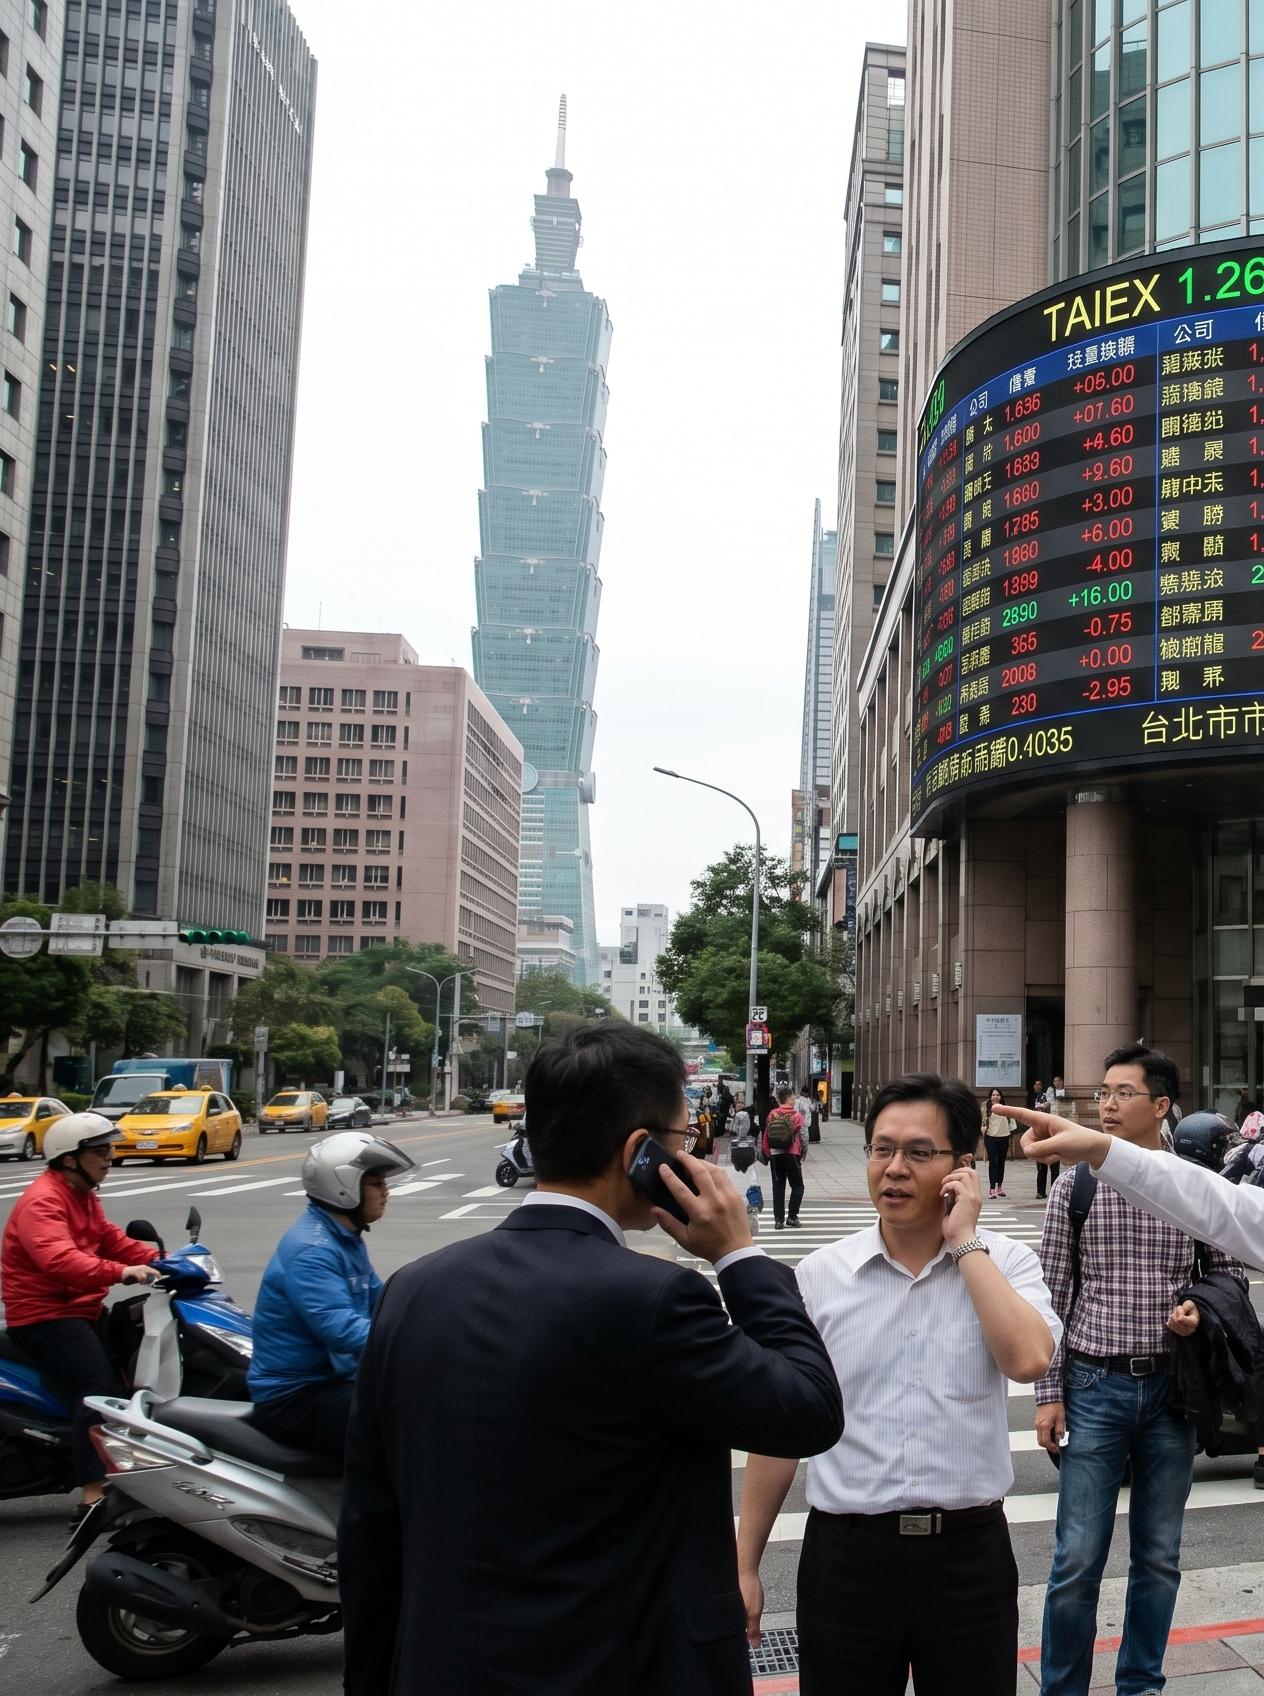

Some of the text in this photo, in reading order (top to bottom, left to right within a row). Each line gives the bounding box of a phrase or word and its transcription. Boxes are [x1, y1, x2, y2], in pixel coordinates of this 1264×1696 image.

[1043, 273, 1161, 342] TAIEX
[1174, 320, 1213, 343] 公司
[1083, 487, 1132, 511] +3.00
[1082, 517, 1132, 542] +6.00
[1088, 549, 1132, 572] -4.00
[1069, 580, 1133, 607] +16.00
[1012, 612, 1131, 654] 365 -0.75
[1003, 644, 1131, 687] 2008 +0.00
[1012, 677, 1130, 715] 230 -2.95
[1007, 726, 1073, 762] 0.4035
